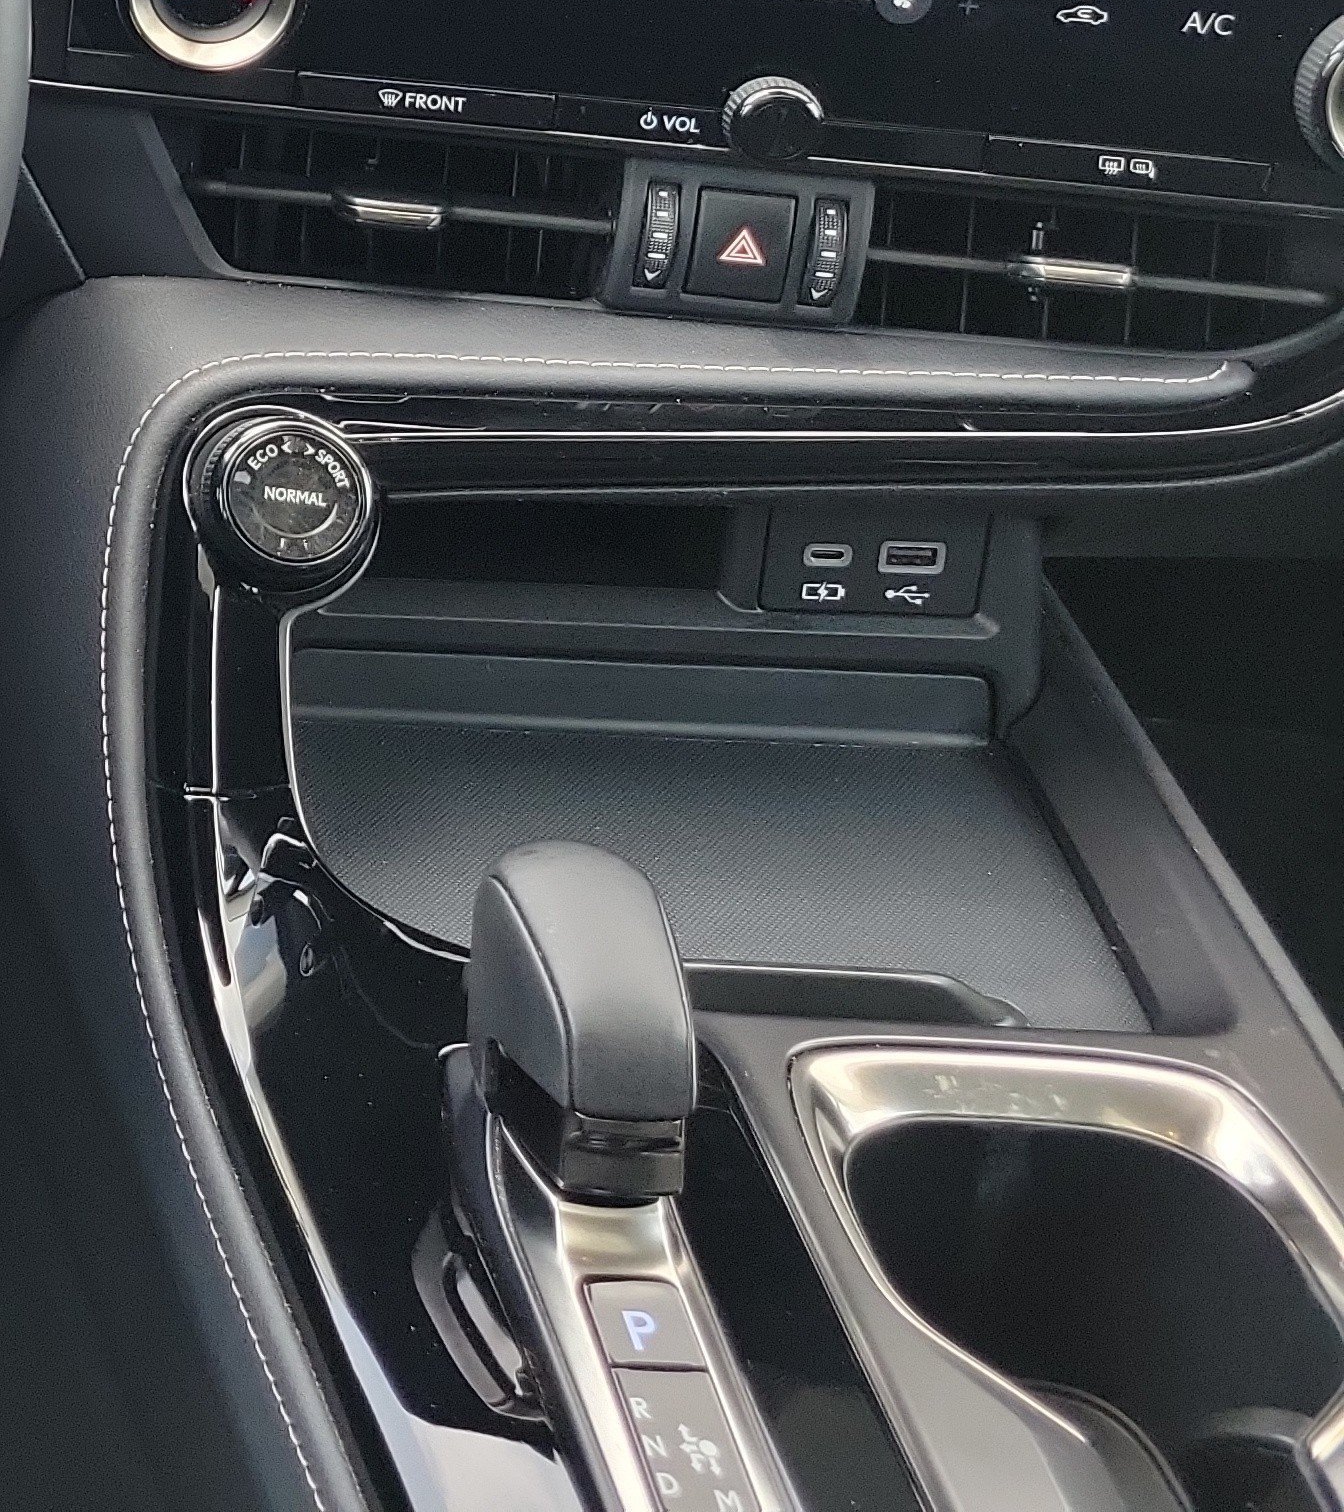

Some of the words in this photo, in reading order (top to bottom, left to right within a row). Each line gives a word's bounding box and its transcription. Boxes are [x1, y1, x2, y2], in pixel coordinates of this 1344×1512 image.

[1183, 10, 1235, 37] A/C
[404, 92, 467, 113] FRONT
[663, 115, 700, 134] VOL
[247, 443, 279, 470] ECO
[315, 449, 350, 489] SPORT
[264, 486, 327, 507] NORMAL
[622, 1310, 656, 1350] P
[630, 1397, 651, 1419] R
[642, 1435, 667, 1457] N
[655, 1473, 679, 1496] D
[714, 1490, 744, 1512] M
